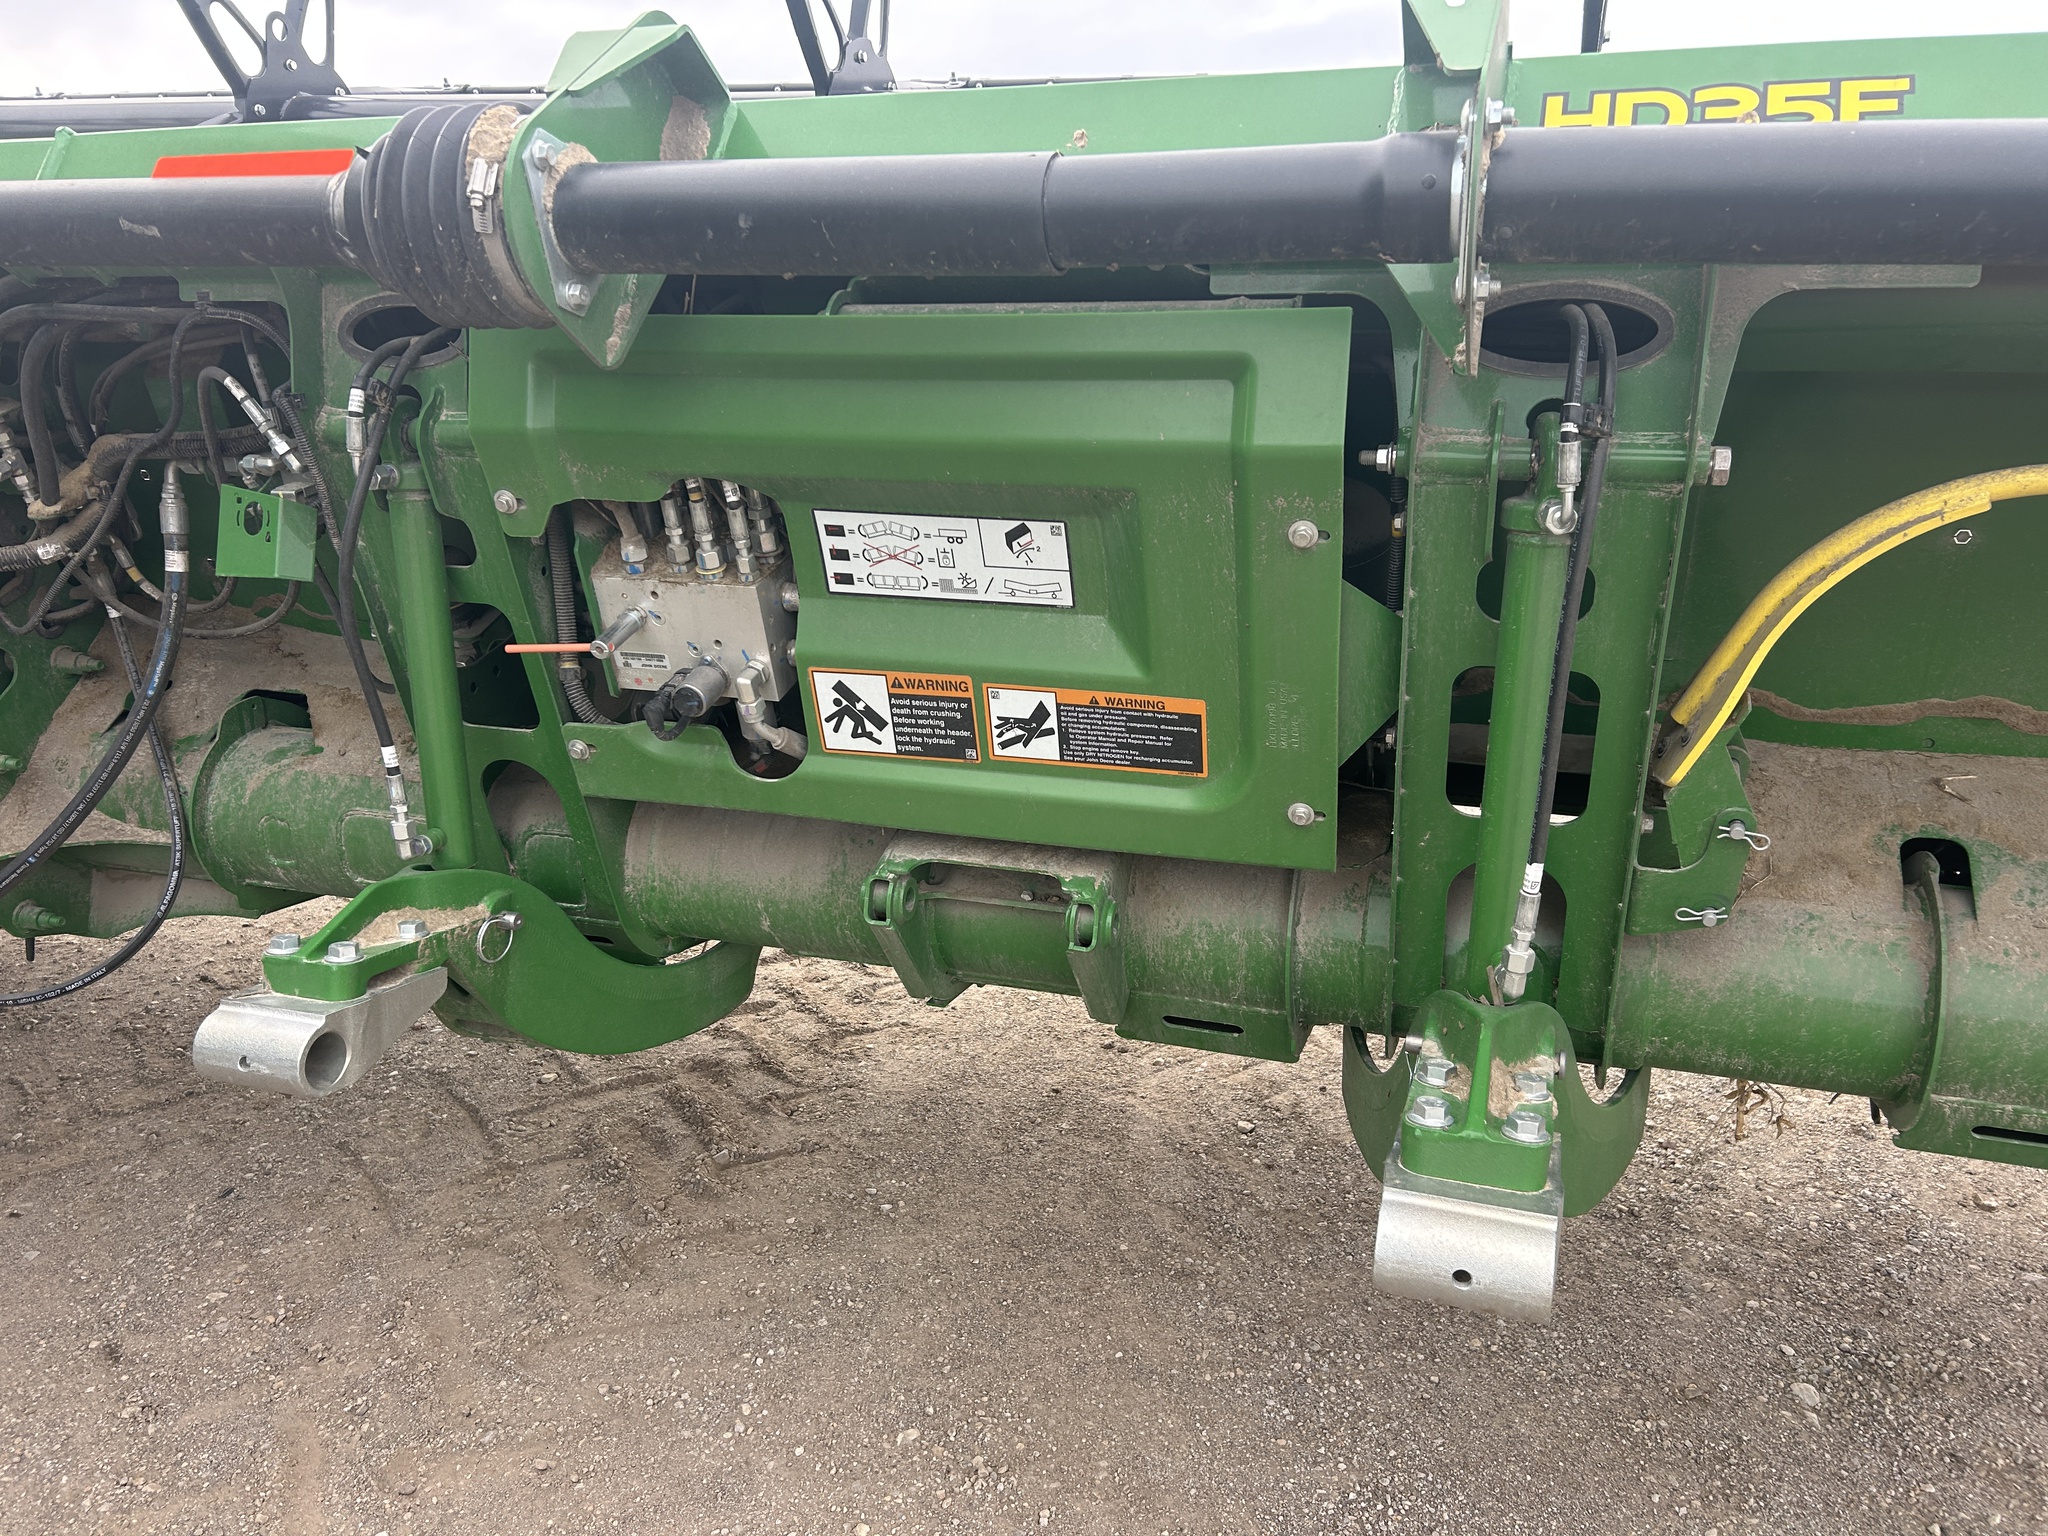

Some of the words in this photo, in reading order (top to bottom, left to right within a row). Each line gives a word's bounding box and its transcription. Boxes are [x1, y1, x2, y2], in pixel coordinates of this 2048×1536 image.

[903, 677, 969, 692] WARNING
[938, 700, 958, 709] injury
[1104, 696, 1165, 710] WARNING
[929, 709, 962, 719] crushing.
[916, 718, 944, 726] working
[894, 726, 933, 734] underneath
[947, 729, 972, 737] header,
[923, 736, 955, 745] hydraulic
[897, 744, 923, 752] system.
[159, 869, 179, 912] ALFAGOMMA
[173, 814, 182, 850] SUPERTUFF
[65, 980, 84, 991] MADE
[90, 966, 107, 979] ITALY
